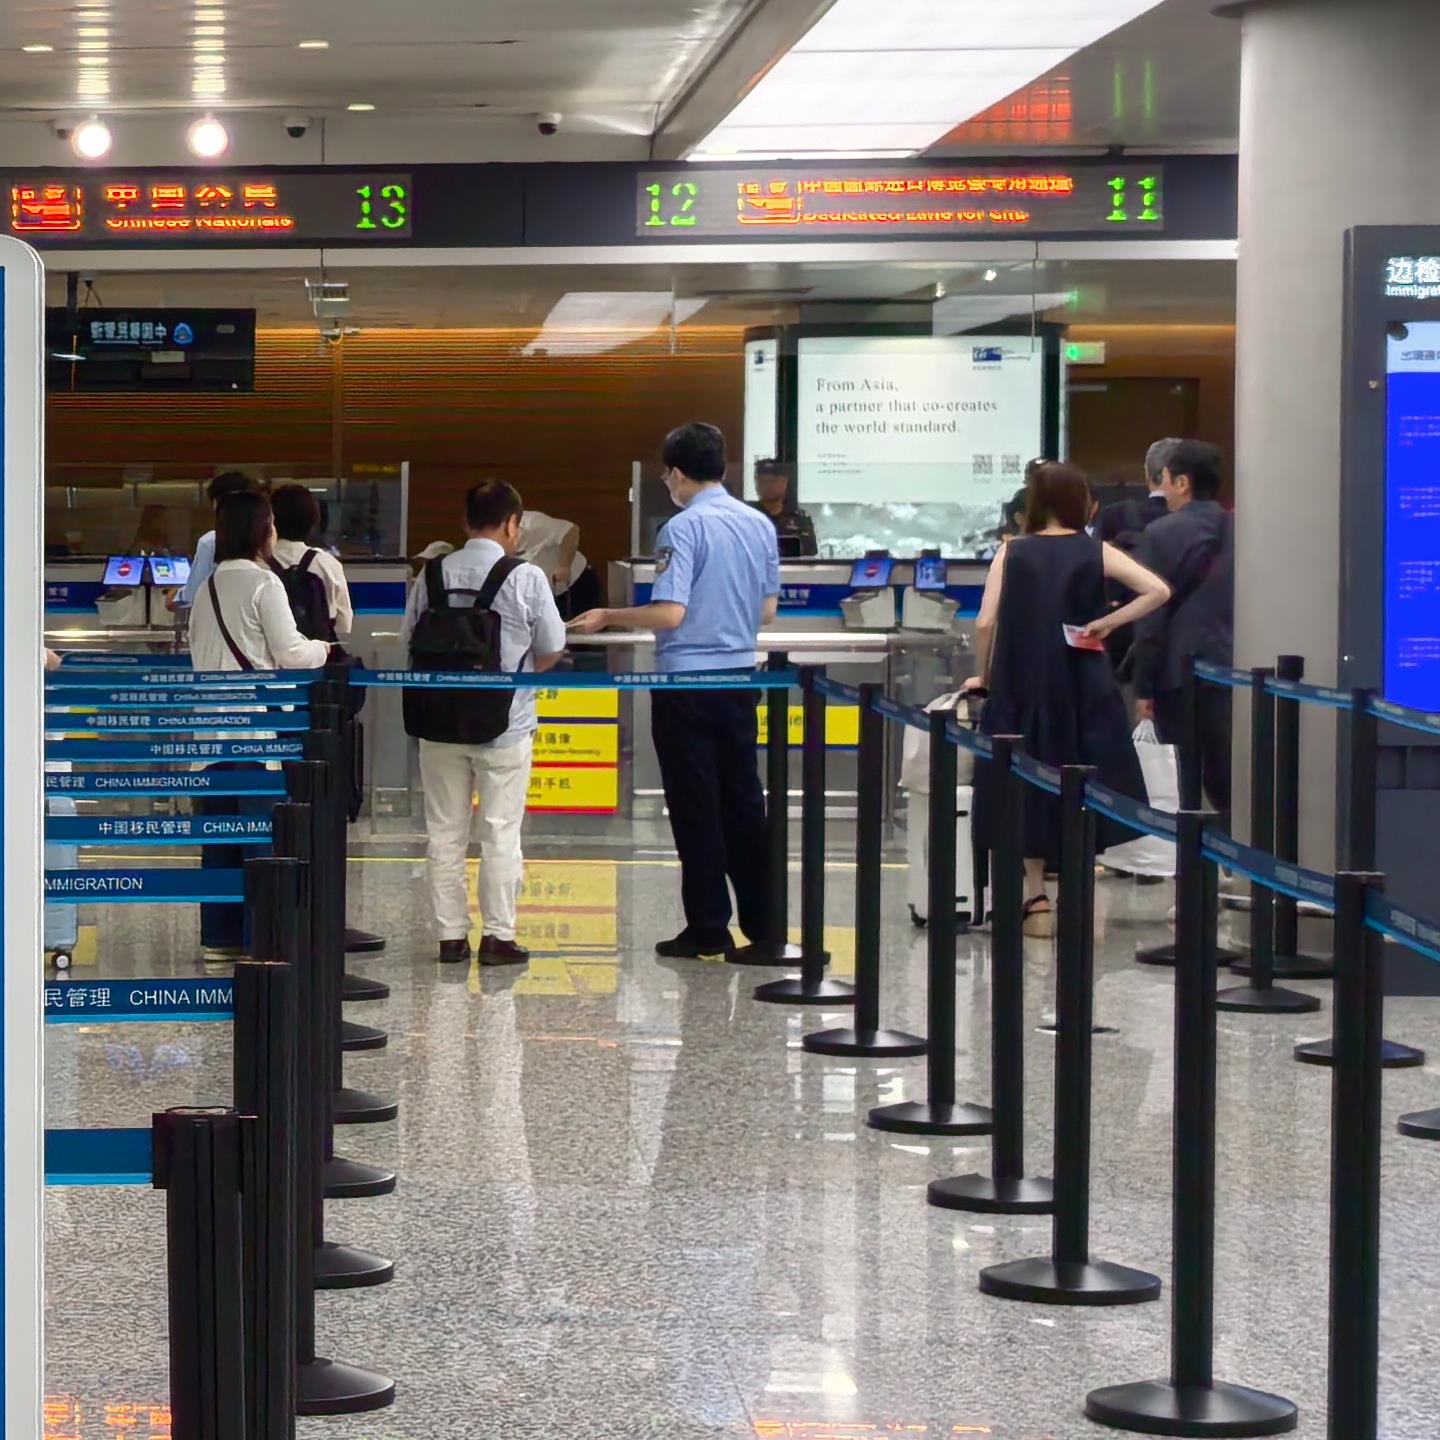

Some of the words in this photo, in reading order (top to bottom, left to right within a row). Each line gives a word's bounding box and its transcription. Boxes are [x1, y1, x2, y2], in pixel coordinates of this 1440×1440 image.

[645, 183, 699, 226] 12
[1107, 177, 1157, 221] 11
[356, 185, 406, 229] 13
[817, 378, 855, 392] From
[829, 402, 883, 416] partner
[889, 400, 916, 412] that
[844, 421, 887, 434] world
[95, 778, 131, 787] CHINA
[99, 821, 191, 834] 中国移民管理
[203, 822, 244, 833] CHINA
[130, 990, 190, 1005] CHINA
